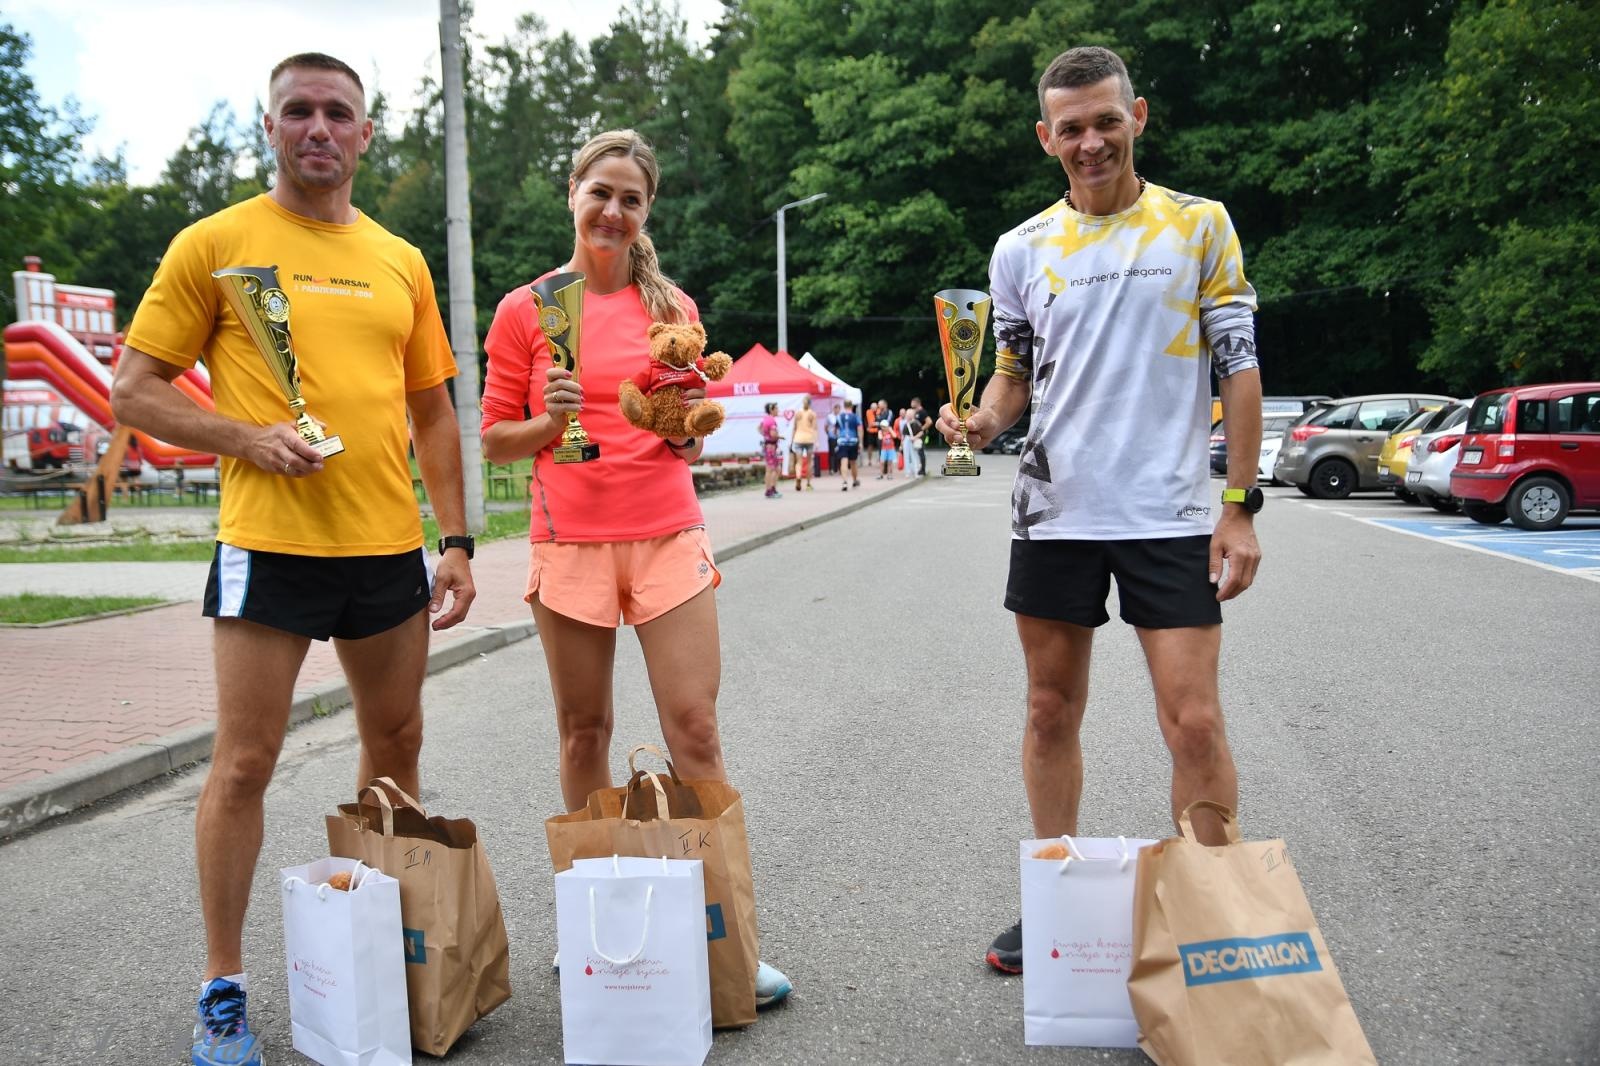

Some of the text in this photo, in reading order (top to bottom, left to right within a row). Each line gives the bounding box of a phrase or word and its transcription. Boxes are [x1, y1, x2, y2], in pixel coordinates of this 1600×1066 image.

[1017, 217, 1054, 236] deep
[293, 273, 371, 289] RUN WARSAW
[699, 831, 711, 849] K
[1186, 941, 1310, 977] DECATHLON
